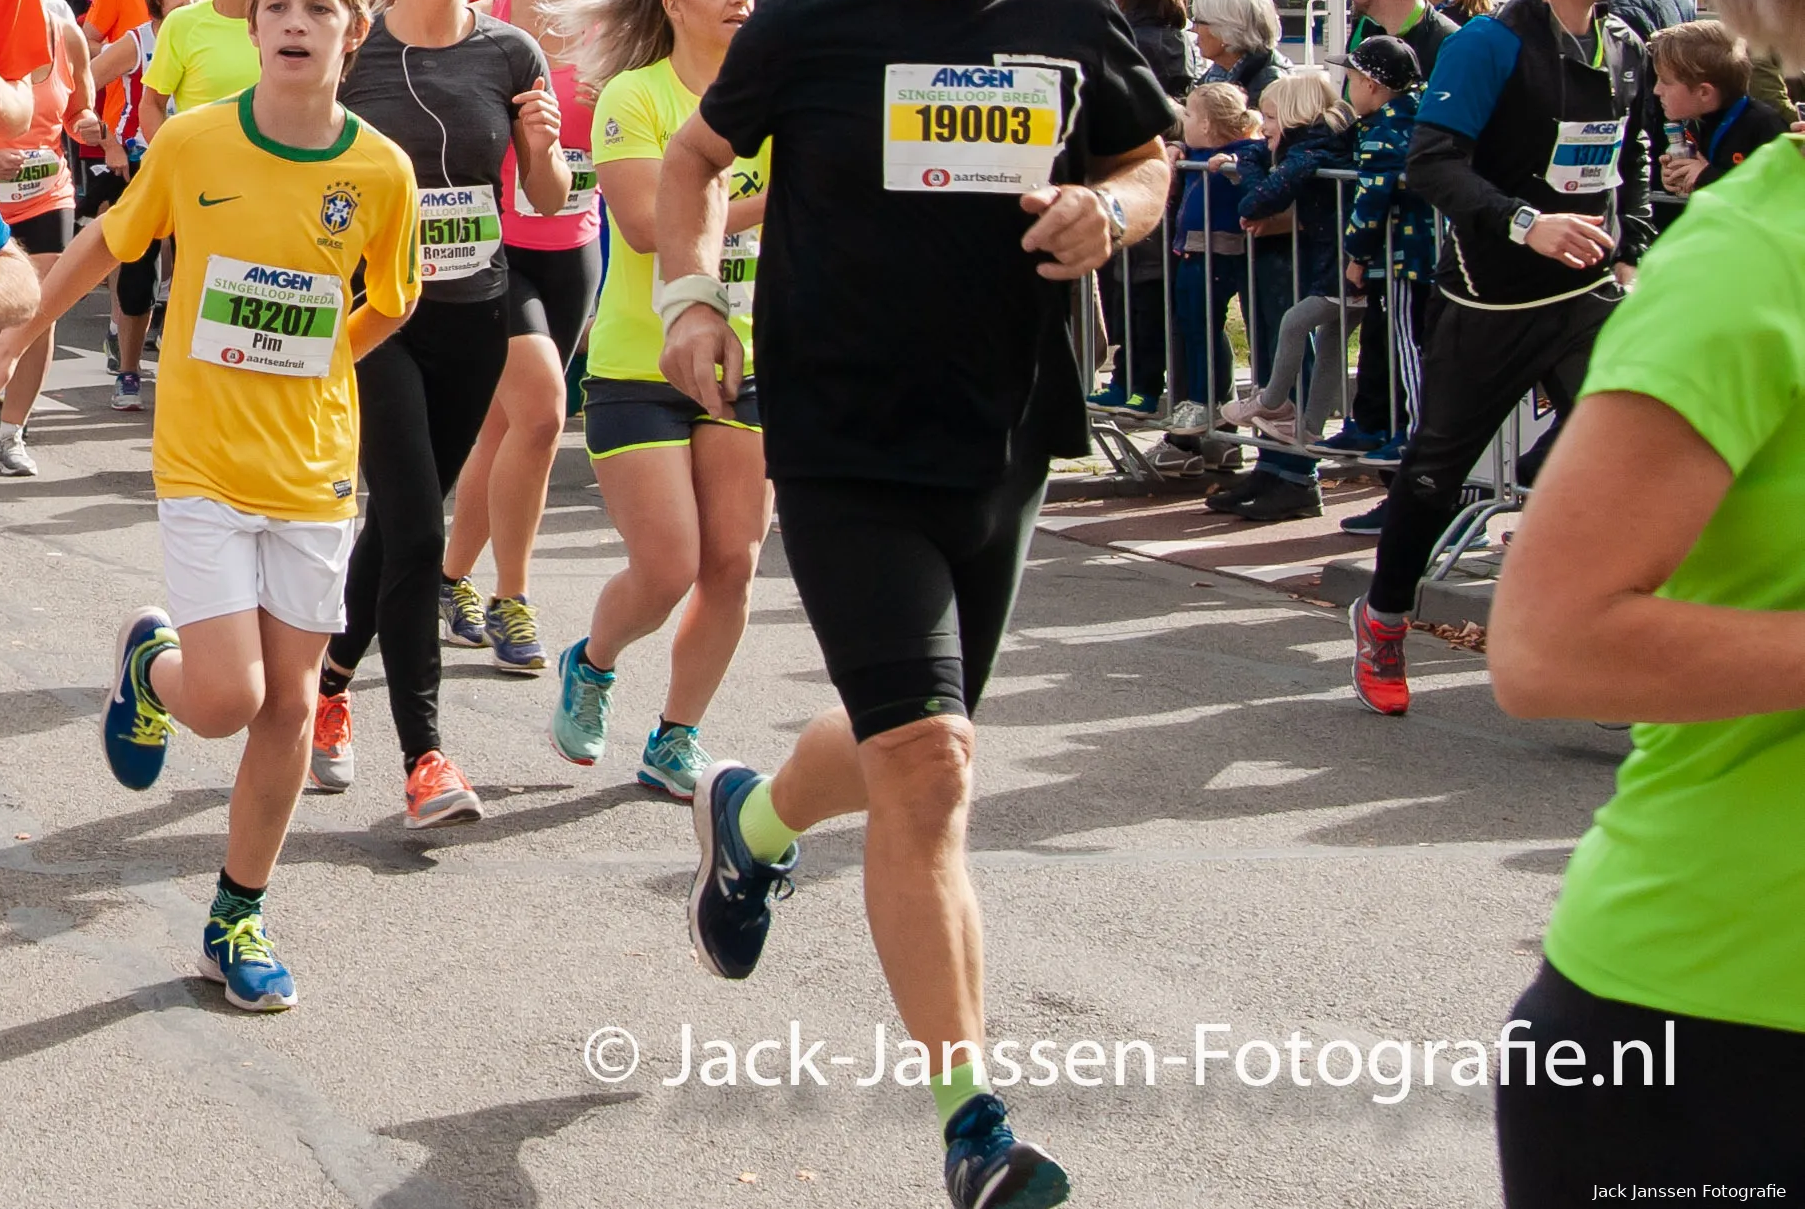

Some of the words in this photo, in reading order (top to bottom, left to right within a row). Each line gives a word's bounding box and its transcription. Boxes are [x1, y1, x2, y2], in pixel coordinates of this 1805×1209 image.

[931, 67, 1015, 88] AMGEN
[898, 89, 997, 103] SINGELLOOP
[1002, 91, 1050, 105] BREDA
[915, 104, 1031, 145] 19003
[953, 170, 1023, 184] aartsenfruit
[420, 191, 473, 207] AMGEN
[423, 245, 476, 260] Roxanne
[243, 266, 314, 292] AMGEN
[214, 278, 295, 301] SINGELLOOP
[298, 294, 335, 305] BREDA
[229, 295, 318, 337] 13207
[252, 332, 283, 352] Pim
[246, 355, 305, 369] aartsenfruit
